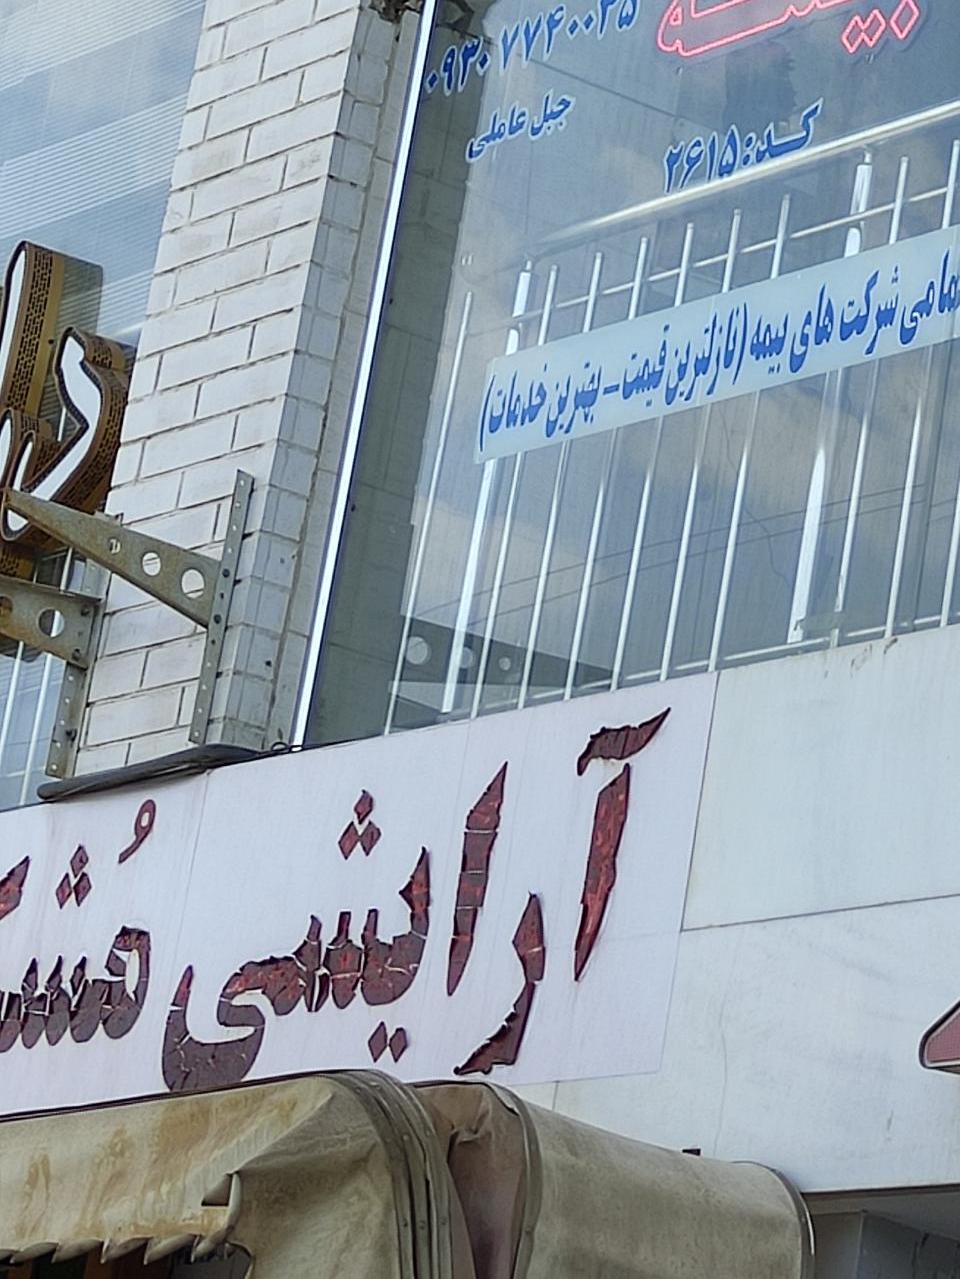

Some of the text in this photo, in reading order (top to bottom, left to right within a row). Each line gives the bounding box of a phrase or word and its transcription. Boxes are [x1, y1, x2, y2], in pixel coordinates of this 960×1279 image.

[466, 89, 575, 162] جبل عاملی
[749, 306, 788, 375] بیمه
[789, 283, 833, 373] های
[839, 265, 899, 356] شرکت
[545, 356, 602, 438] بهترین
[621, 324, 670, 408] قیمت
[162, 707, 671, 1092] آرایشی
